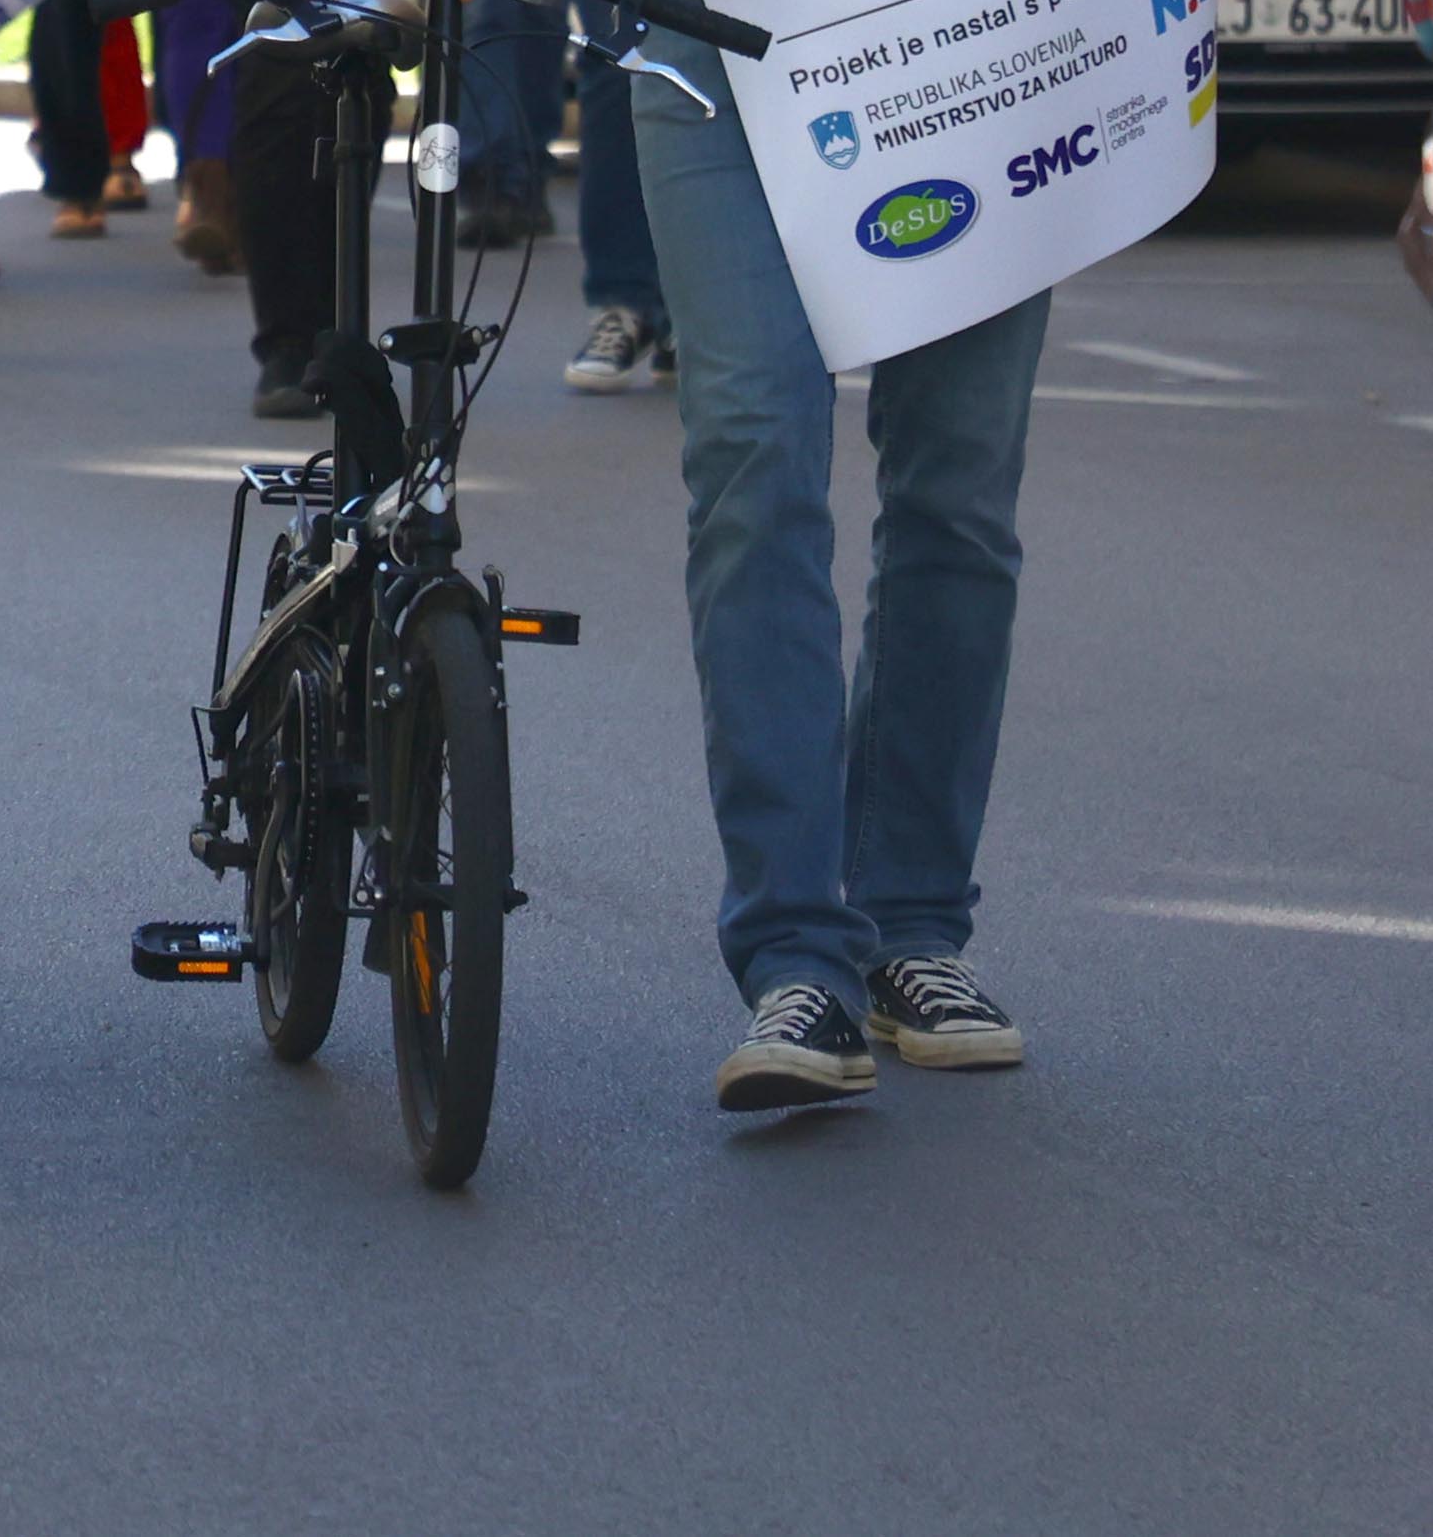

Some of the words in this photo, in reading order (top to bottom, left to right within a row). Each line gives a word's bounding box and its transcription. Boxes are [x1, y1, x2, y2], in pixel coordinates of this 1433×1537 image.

[788, 43, 893, 95] Projekt
[896, 36, 925, 66] je
[932, 0, 1017, 49] nastal
[864, 69, 987, 125] REPUBLIKA
[988, 27, 1087, 83] SLOVENIJA
[873, 87, 1016, 152] MINISTRSTVO
[1018, 76, 1046, 101] ZA
[1047, 34, 1128, 89] KULTURO
[1006, 124, 1100, 198] SMC
[867, 193, 967, 246] DeSUS
